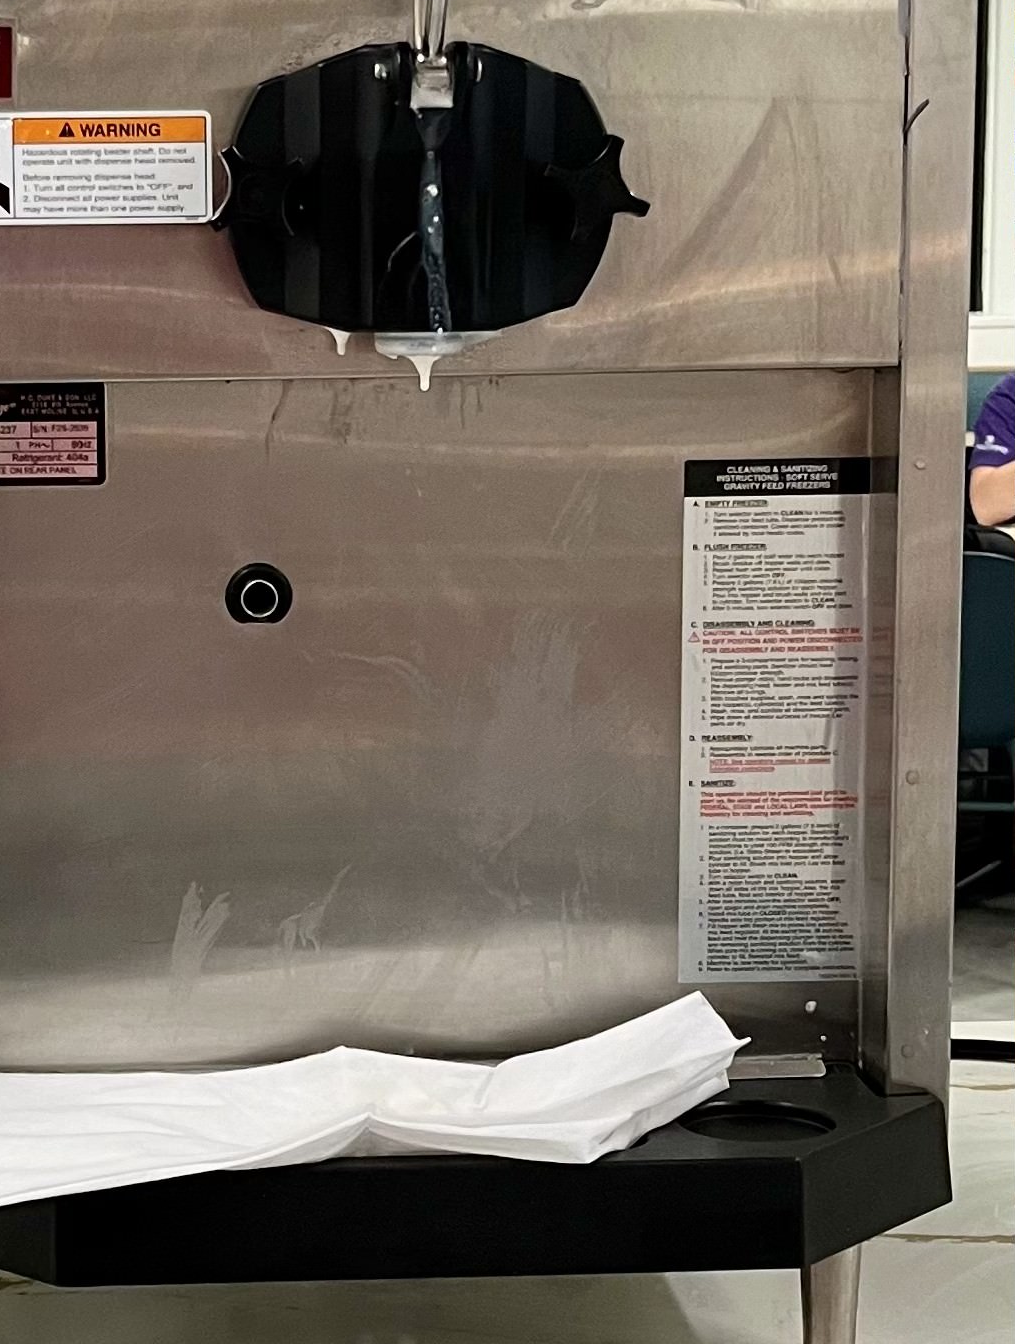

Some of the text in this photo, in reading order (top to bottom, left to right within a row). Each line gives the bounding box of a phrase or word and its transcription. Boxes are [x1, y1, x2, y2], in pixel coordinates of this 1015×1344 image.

[81, 123, 161, 138] WARNING
[24, 466, 48, 474] REAR
[717, 474, 779, 482] INSTRUCTIONS
[786, 481, 831, 489] FREEZERS
